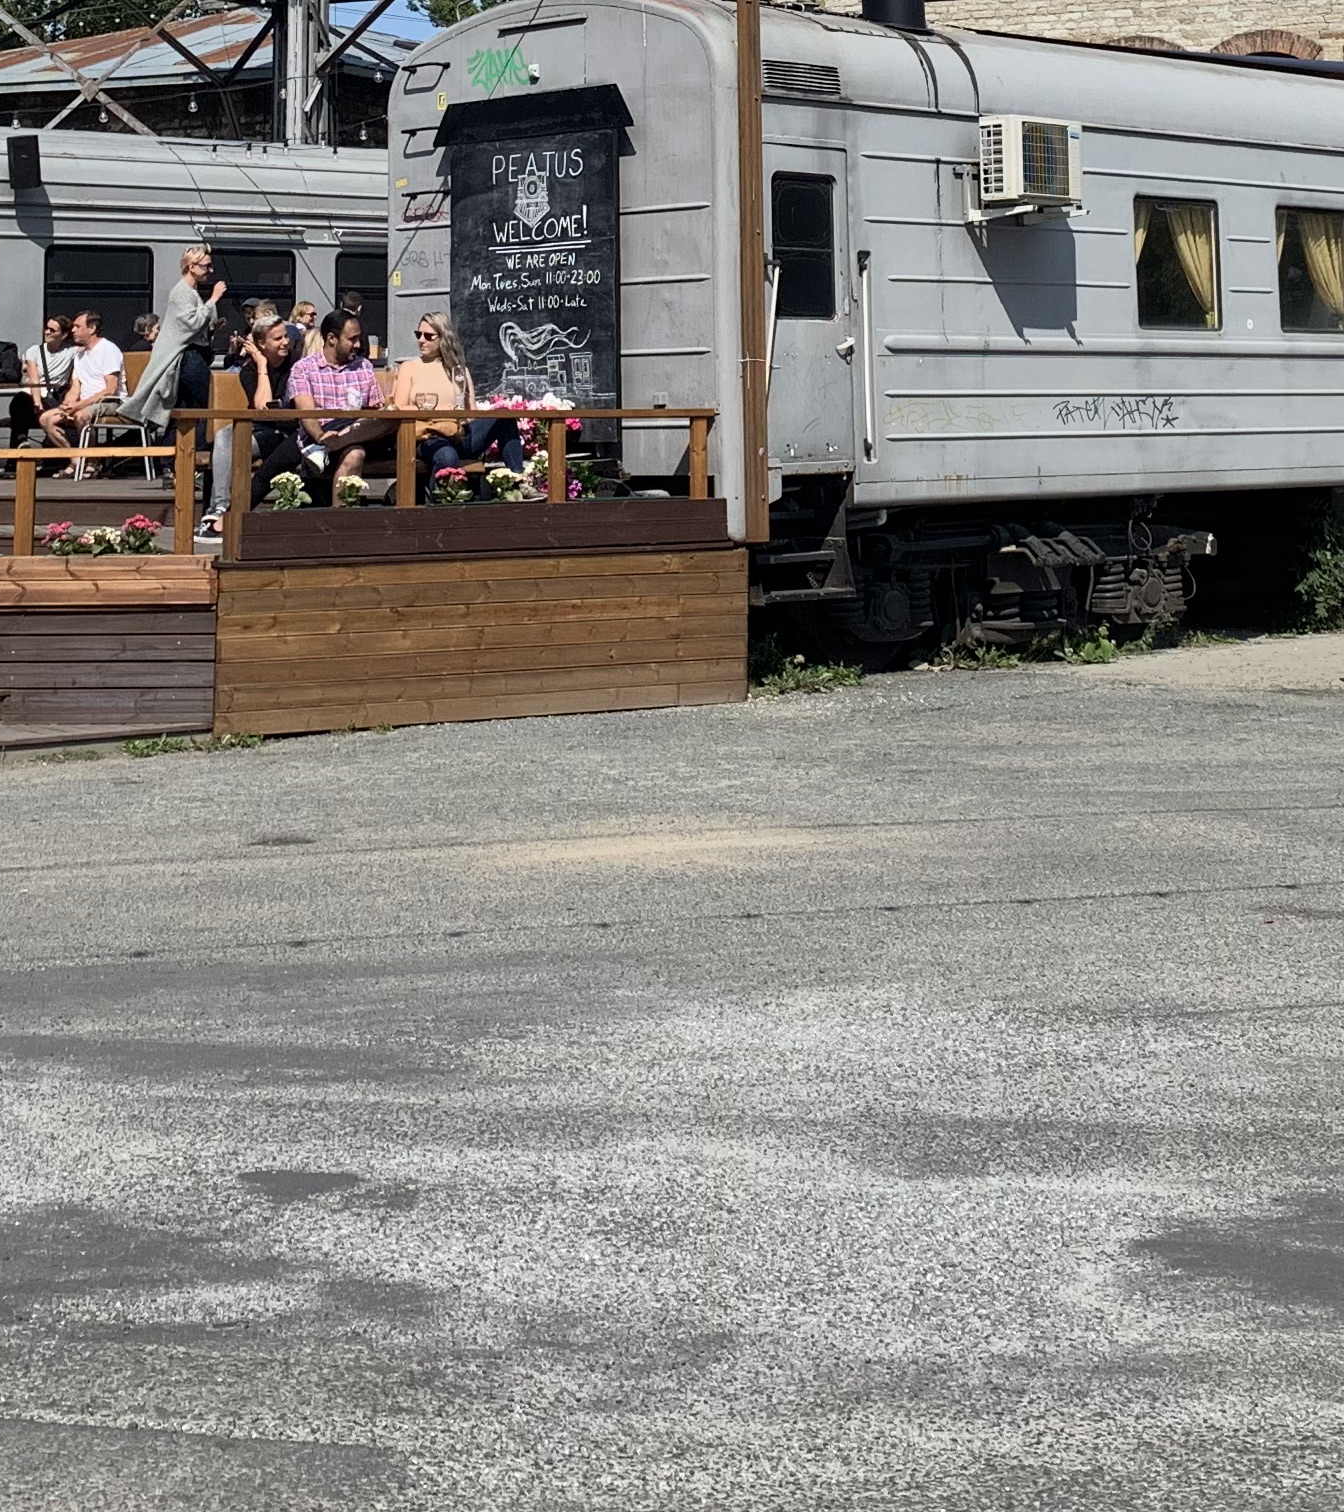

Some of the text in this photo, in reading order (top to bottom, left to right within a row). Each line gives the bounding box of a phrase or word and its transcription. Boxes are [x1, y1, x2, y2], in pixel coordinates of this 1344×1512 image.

[492, 149, 584, 184] PEATUS
[493, 205, 587, 243] WELCOME!
[506, 252, 575, 269] WE ARE OPEN
